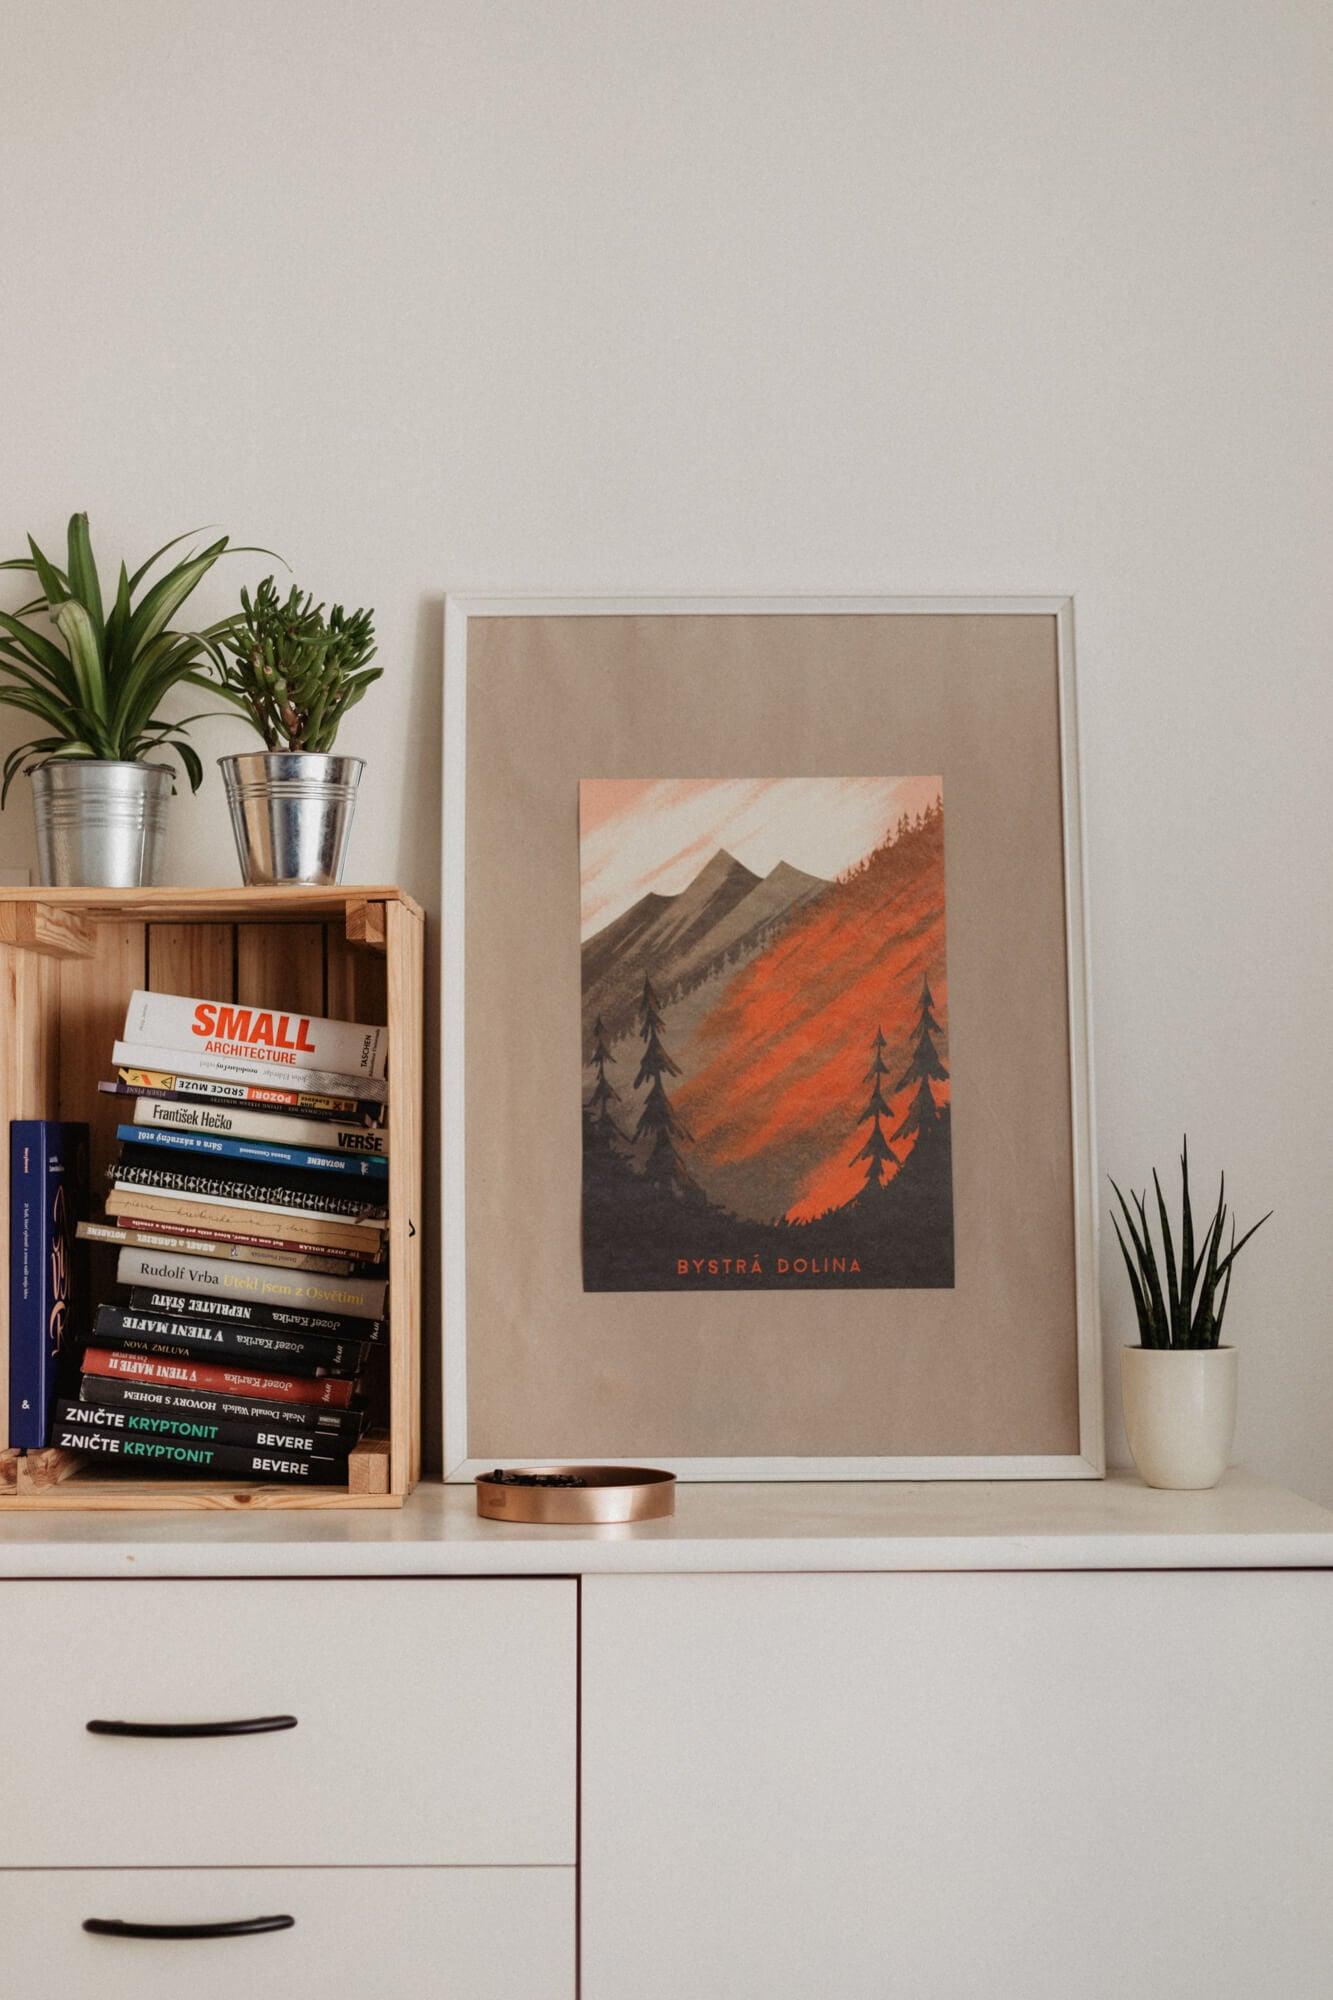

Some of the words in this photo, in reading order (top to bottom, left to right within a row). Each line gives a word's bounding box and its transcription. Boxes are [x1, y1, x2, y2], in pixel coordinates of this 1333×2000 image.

[191, 1003, 315, 1053] SMALL
[204, 1040, 297, 1065] ARCHITECTURE
[360, 1034, 372, 1068] TASCHEN
[211, 1084, 244, 1097] SRDCE
[251, 1089, 291, 1103] POZOR!
[153, 1104, 198, 1124] František
[201, 1112, 233, 1130] Hečko
[204, 1142, 223, 1151] Sára
[337, 1130, 383, 1152] VERŠE
[307, 1156, 345, 1169] NOTABENE
[677, 1253, 763, 1274] BYSTRÁ
[777, 1257, 861, 1273] DOLINA
[140, 1263, 186, 1280] Rudolf
[189, 1269, 220, 1285] Vrba
[261, 1282, 292, 1297] jsem
[295, 1288, 303, 1296] z
[307, 1287, 364, 1305] Osvětimi
[151, 1294, 186, 1313] ŠTÁTU
[188, 1299, 252, 1320] NEPRIATEĽ
[122, 1316, 170, 1333] MAFIE
[272, 1312, 309, 1326] Karika
[311, 1318, 341, 1331] Jozef
[171, 1324, 213, 1341] TIENI
[213, 1330, 224, 1342] V
[236, 1334, 273, 1349] Karika
[273, 1339, 305, 1353] Jozef
[151, 1343, 190, 1356] ZMLUVA
[108, 1358, 119, 1369] II
[120, 1359, 155, 1376] MAFIE
[157, 1365, 189, 1380] TIENI
[190, 1370, 198, 1382] V
[224, 1373, 261, 1388] Karika
[261, 1379, 293, 1391] Jozef
[123, 1390, 163, 1404] BOHEM
[164, 1395, 172, 1405] S
[172, 1396, 217, 1411] HOVORY
[222, 1403, 250, 1416] Walsch
[250, 1407, 281, 1420] Donald
[65, 1408, 125, 1427] ZNIČTE
[128, 1416, 219, 1439] KRYPTONIT
[282, 1412, 306, 1423] Neale
[60, 1433, 120, 1453] ZNIČTE
[123, 1441, 214, 1464] KRYPTONIT
[256, 1432, 314, 1451] BEVERE
[252, 1457, 310, 1475] BEVERE
